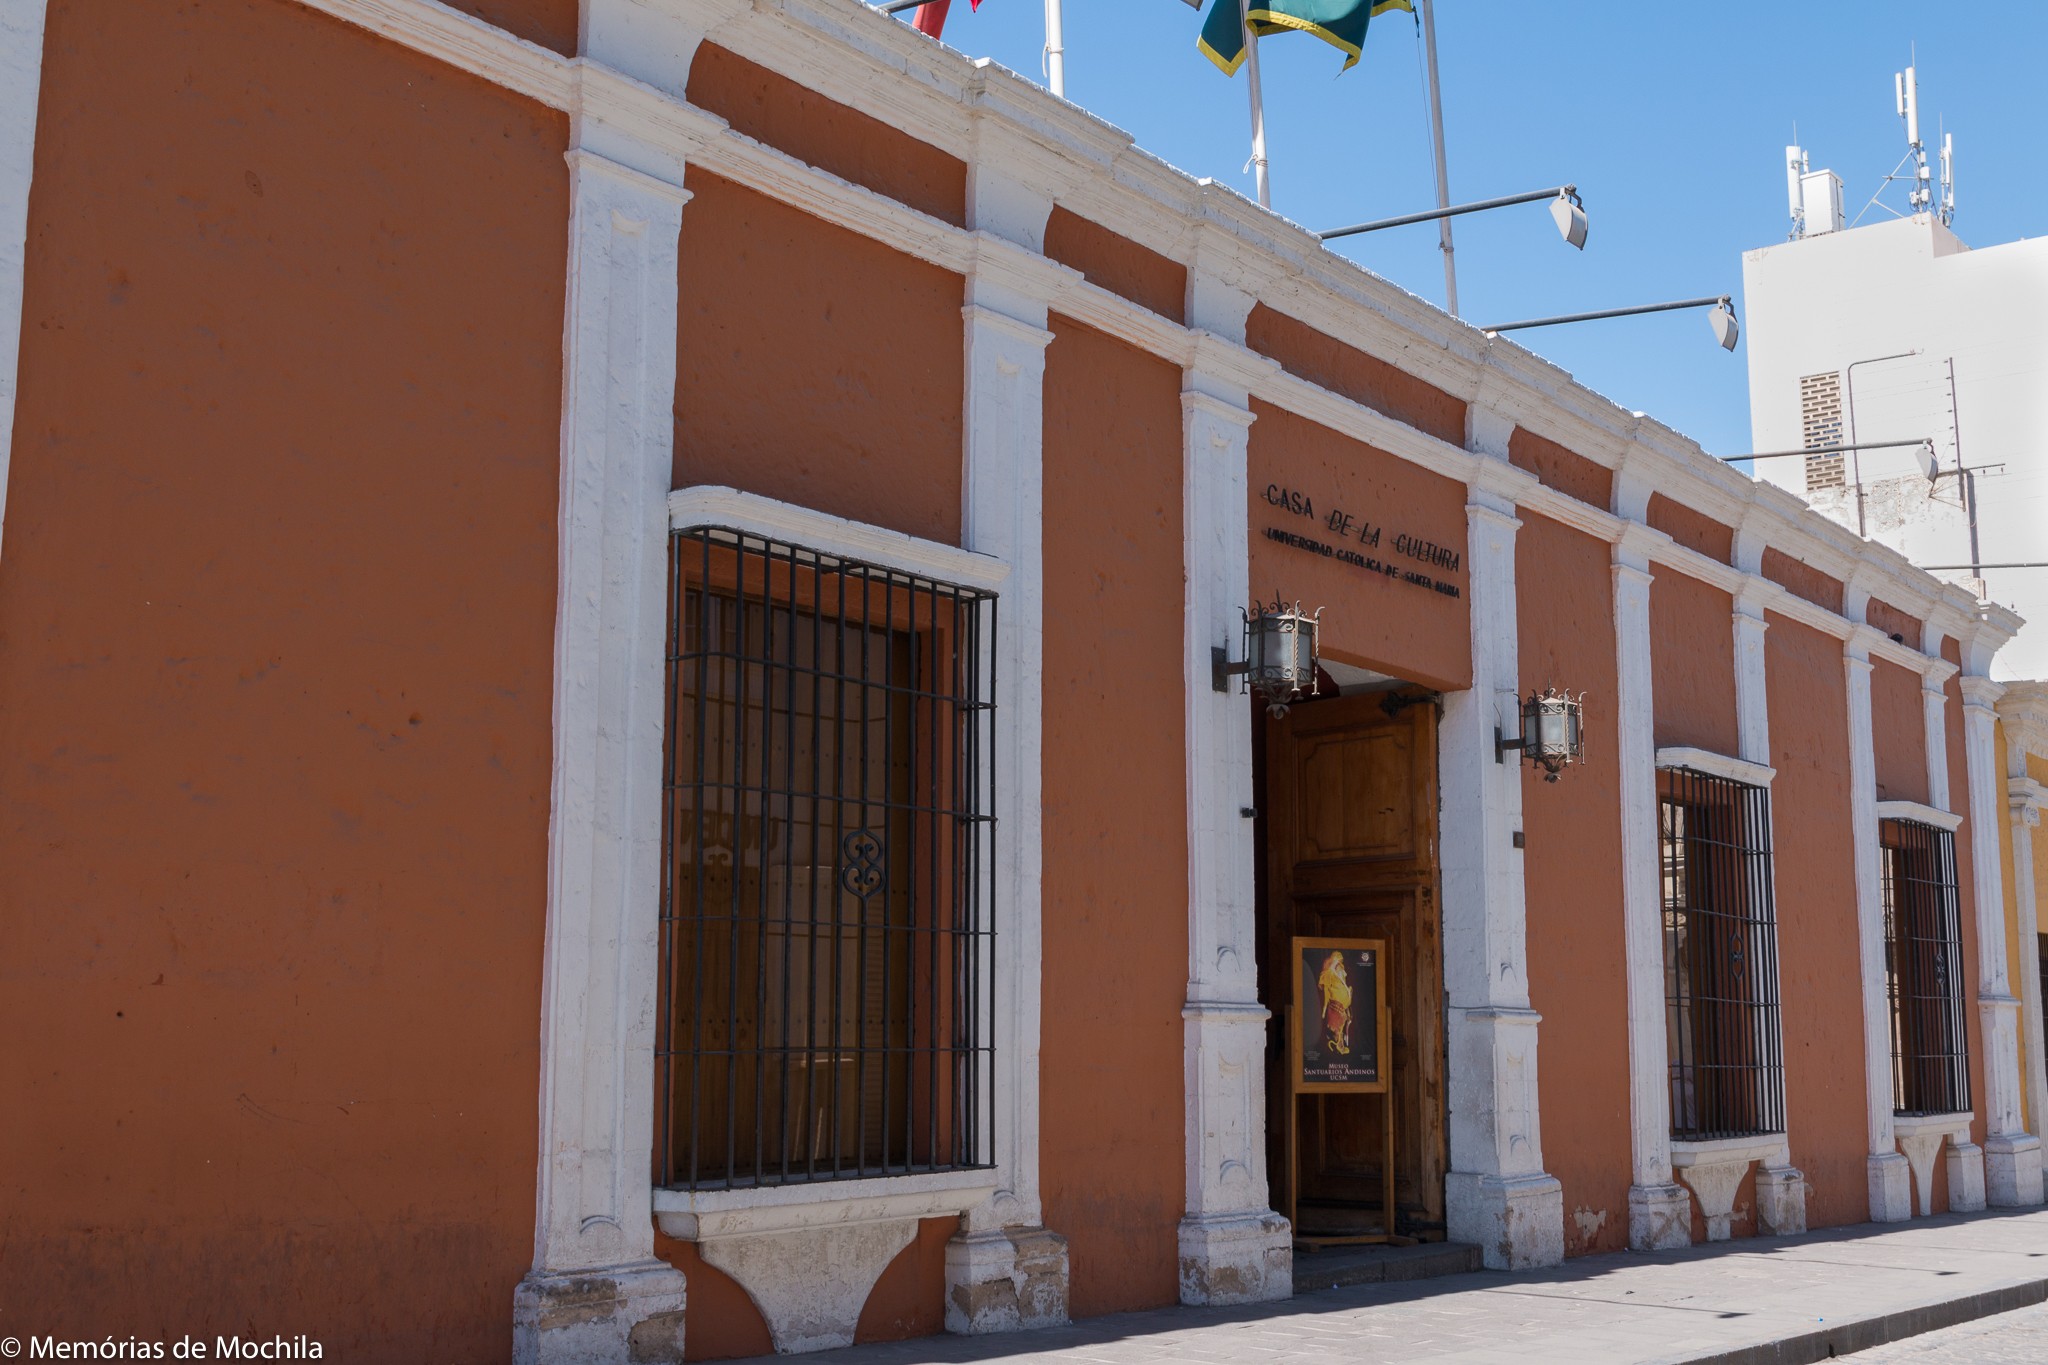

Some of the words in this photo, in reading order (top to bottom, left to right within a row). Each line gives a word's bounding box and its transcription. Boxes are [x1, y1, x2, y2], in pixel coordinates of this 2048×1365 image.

[1267, 484, 1314, 520] CASA
[1328, 509, 1354, 537] DE
[1360, 522, 1381, 549] LA
[1396, 533, 1460, 573] CULTURA
[1267, 527, 1333, 557] UNIVERSIDAD
[1336, 548, 1382, 573] CATOLICA
[1385, 564, 1400, 579] DE
[1404, 571, 1432, 590] SANTA
[1434, 580, 1460, 599] MARIA
